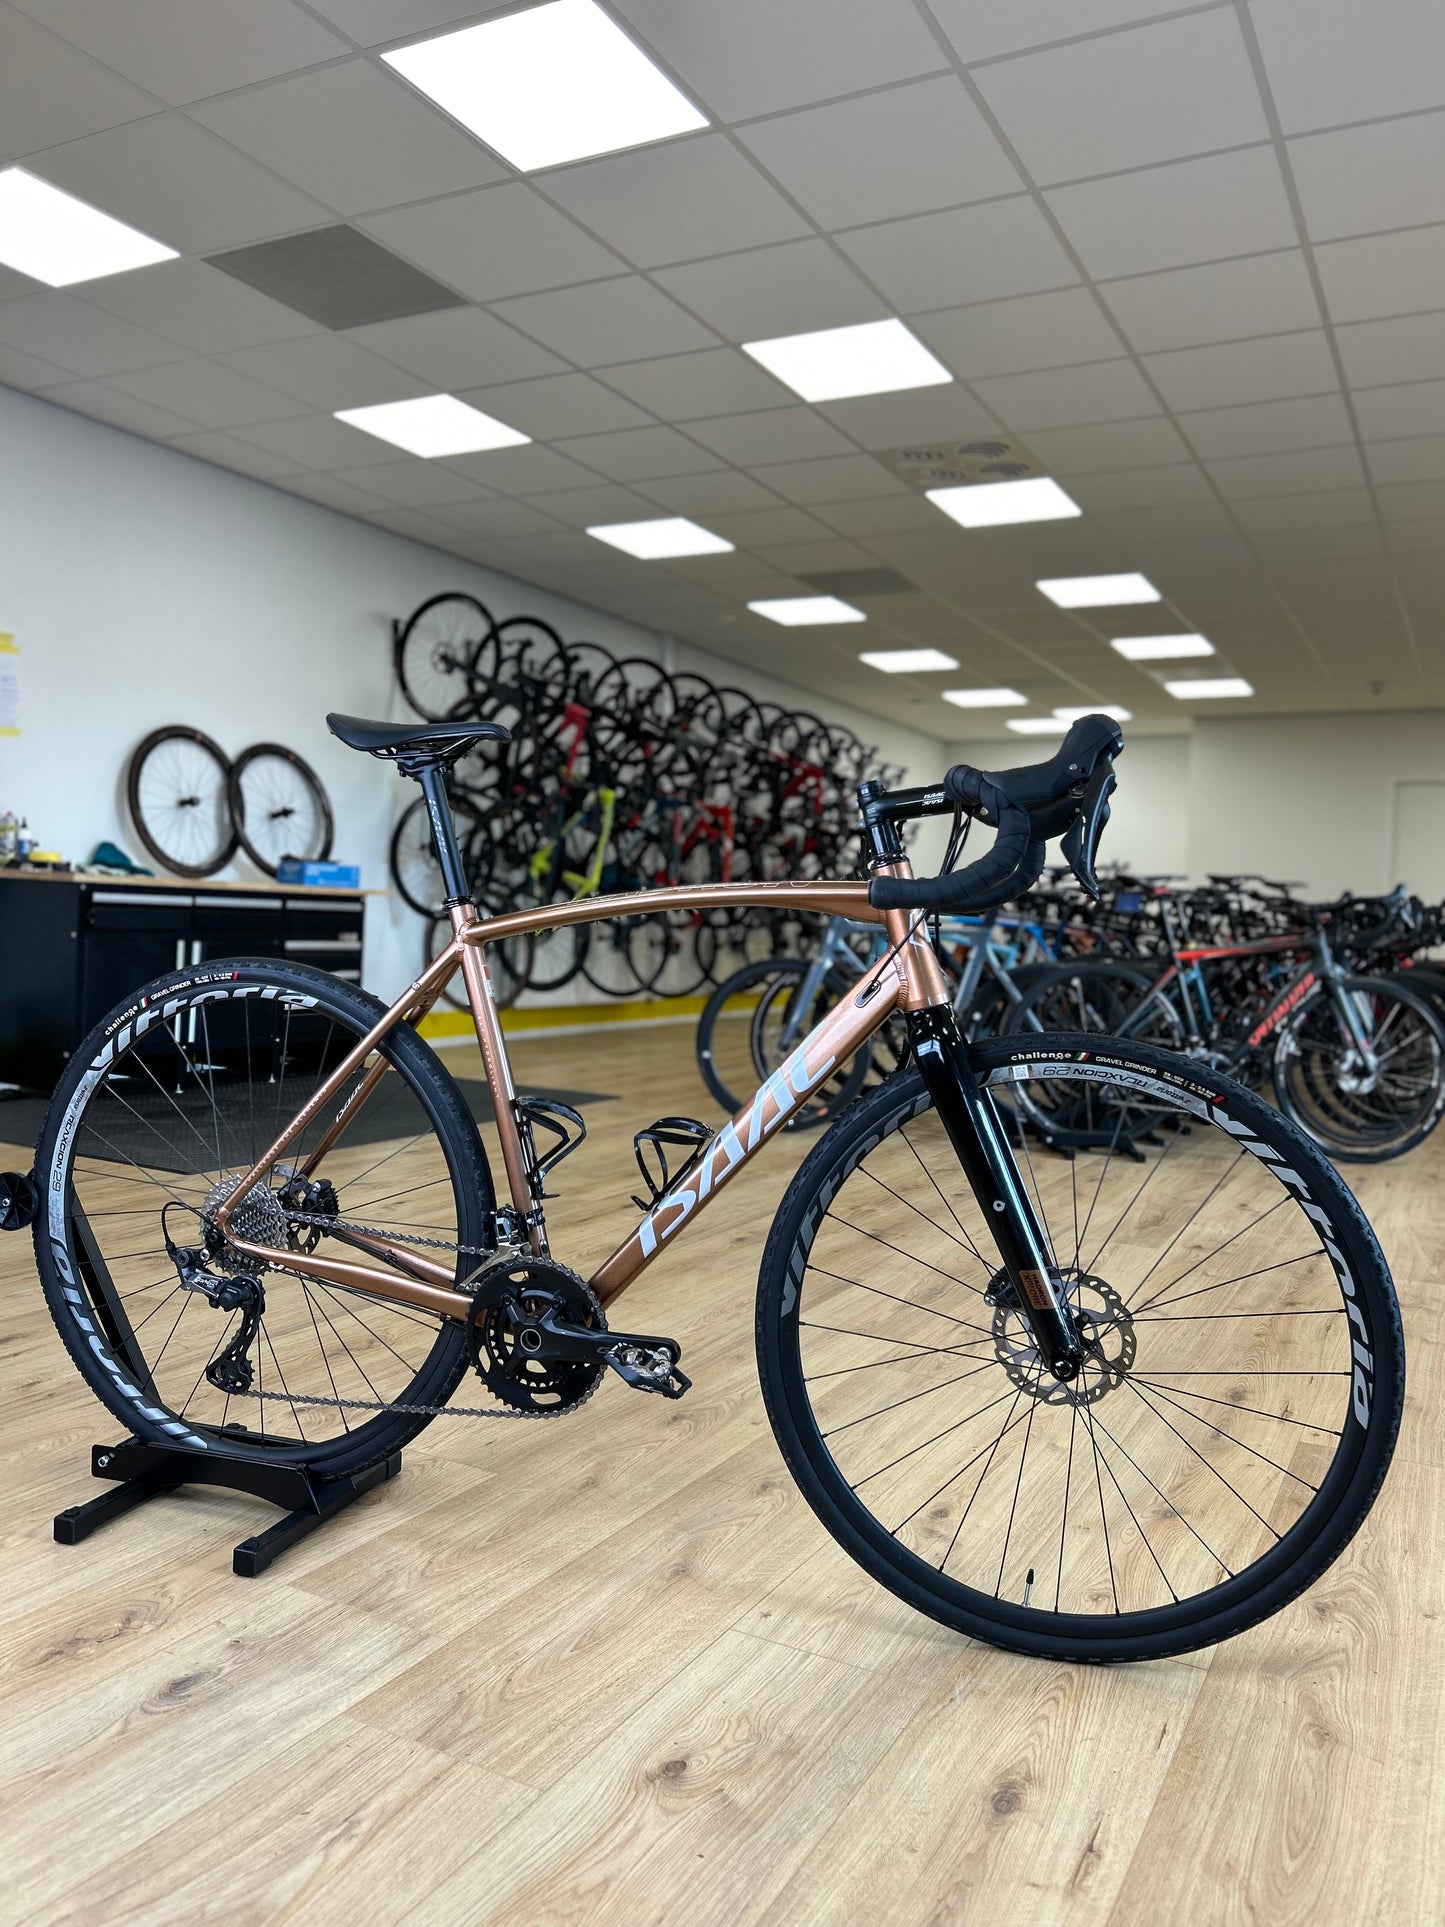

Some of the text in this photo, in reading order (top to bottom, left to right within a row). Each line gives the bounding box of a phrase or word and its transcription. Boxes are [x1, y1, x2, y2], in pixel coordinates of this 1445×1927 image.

[90, 985, 320, 1068] vittoria
[104, 980, 192, 1036] challenge GRAVEL GRINDER
[1010, 1051, 1157, 1075] challenge GRAVEL GRINDER
[1042, 1066, 1071, 1076] 29
[639, 1019, 836, 1258] ISAAC
[52, 1170, 63, 1192] 29
[781, 1091, 936, 1318] vittori
[1032, 1273, 1048, 1306] HADRON
[1212, 1105, 1375, 1430] vittoria
[1024, 1274, 1039, 1306] XPLORE
